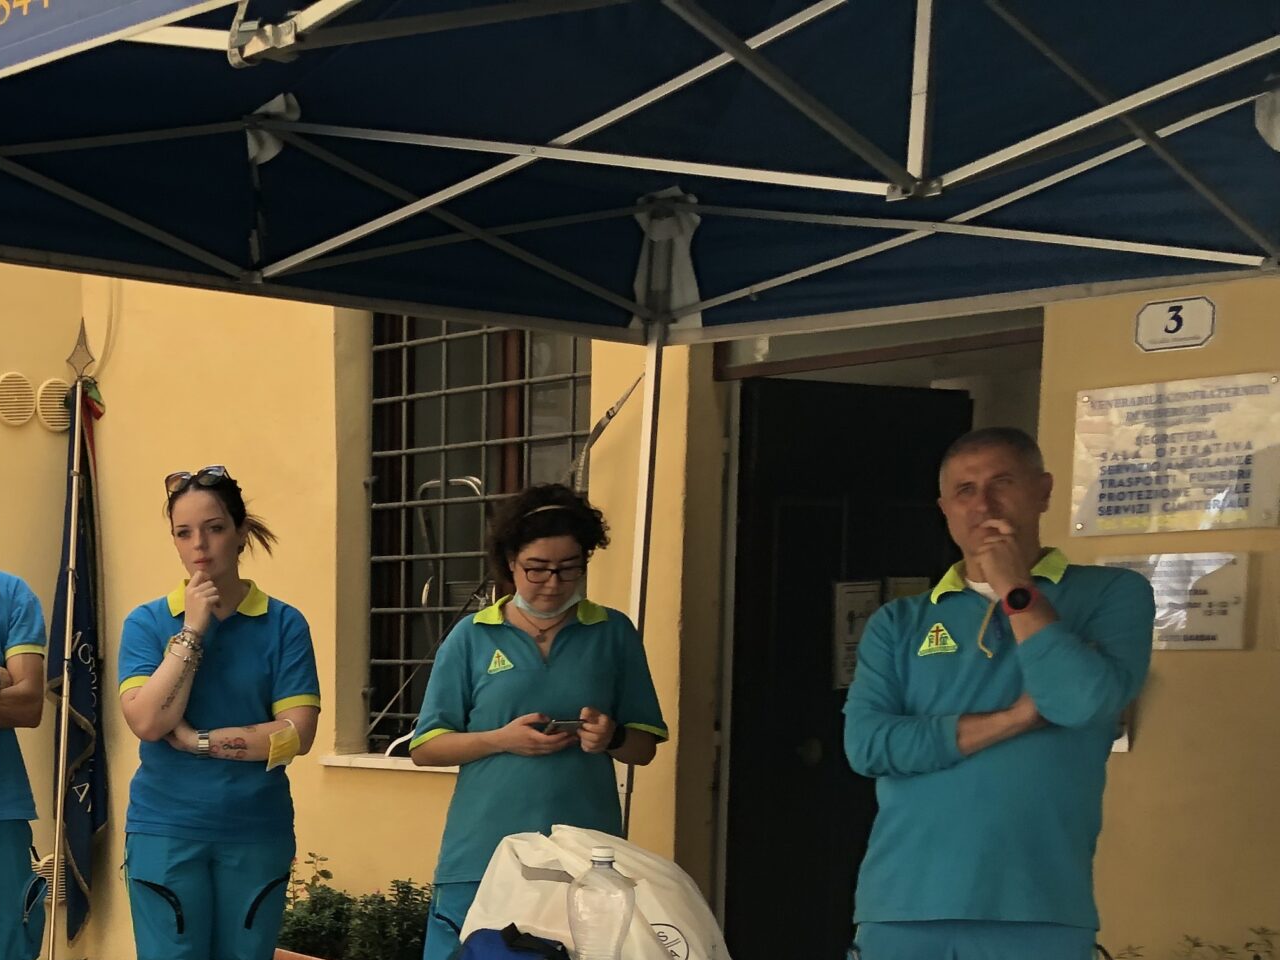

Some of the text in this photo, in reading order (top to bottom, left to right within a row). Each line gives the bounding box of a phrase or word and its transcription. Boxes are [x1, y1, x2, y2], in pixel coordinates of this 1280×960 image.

[1164, 305, 1183, 334] 3
[1156, 440, 1252, 457] OPERATIVA
[1099, 474, 1177, 489] TRASPORTI
[1098, 487, 1190, 503] PROTEZIONE
[1097, 503, 1150, 517] SERVIZI
